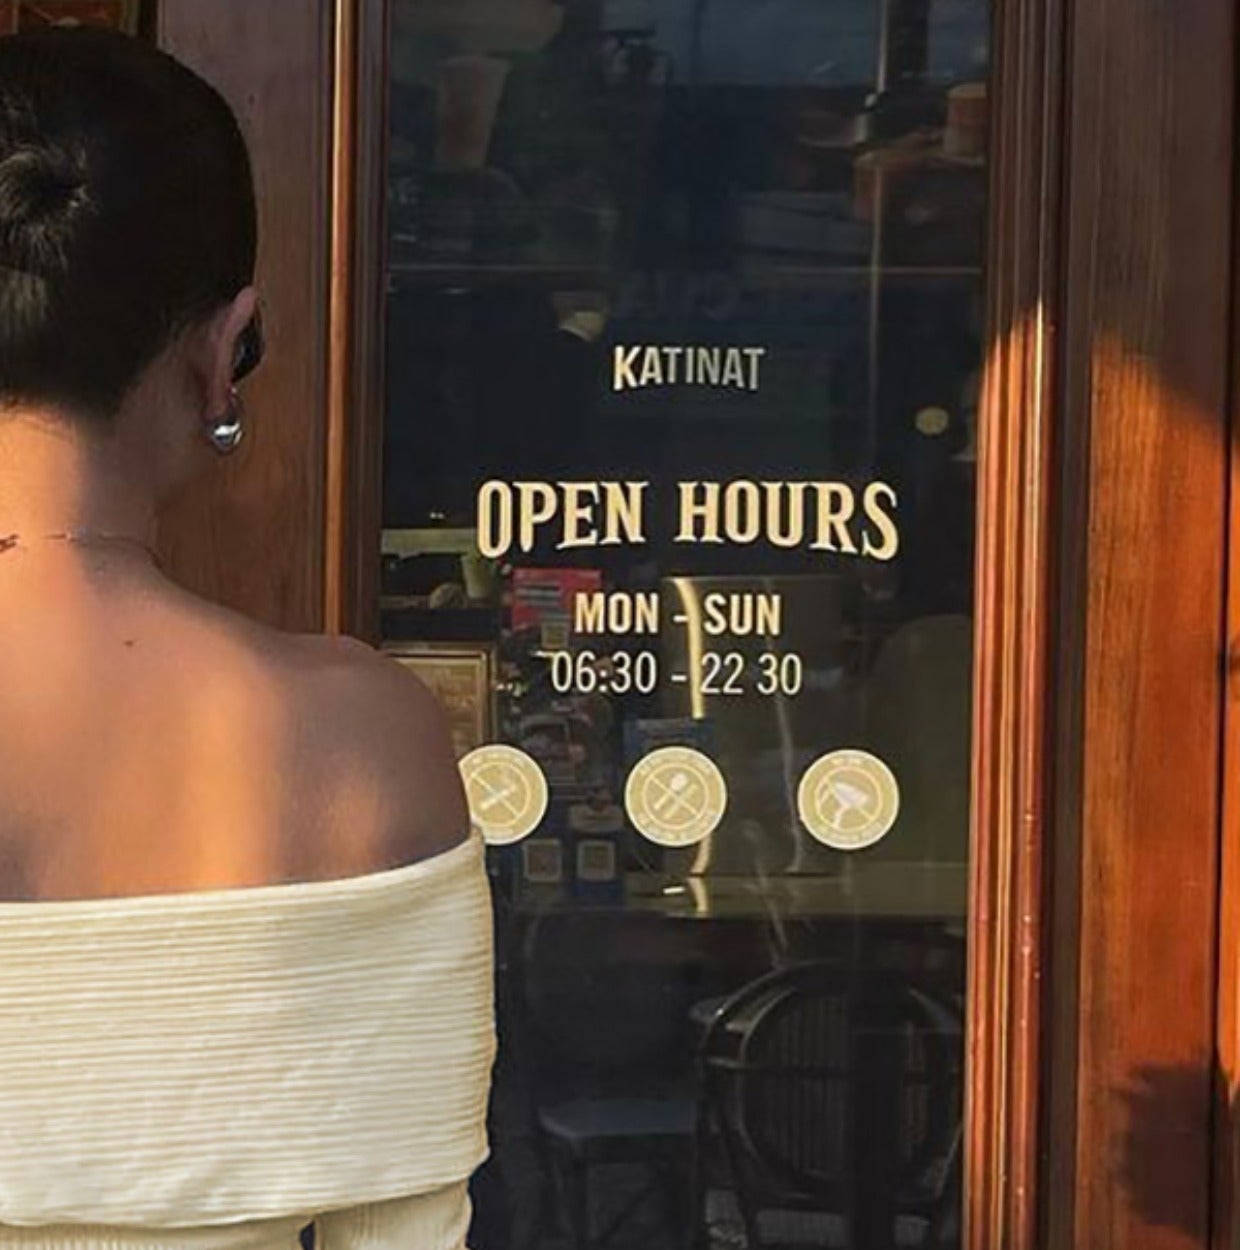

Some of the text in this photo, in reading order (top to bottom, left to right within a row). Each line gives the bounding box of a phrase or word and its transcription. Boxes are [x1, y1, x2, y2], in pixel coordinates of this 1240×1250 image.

[613, 345, 765, 390] KATINAT
[477, 479, 900, 561] OPEN HOURS
[574, 592, 659, 634] MON
[703, 593, 781, 635] SUN
[551, 650, 658, 693] 06:30
